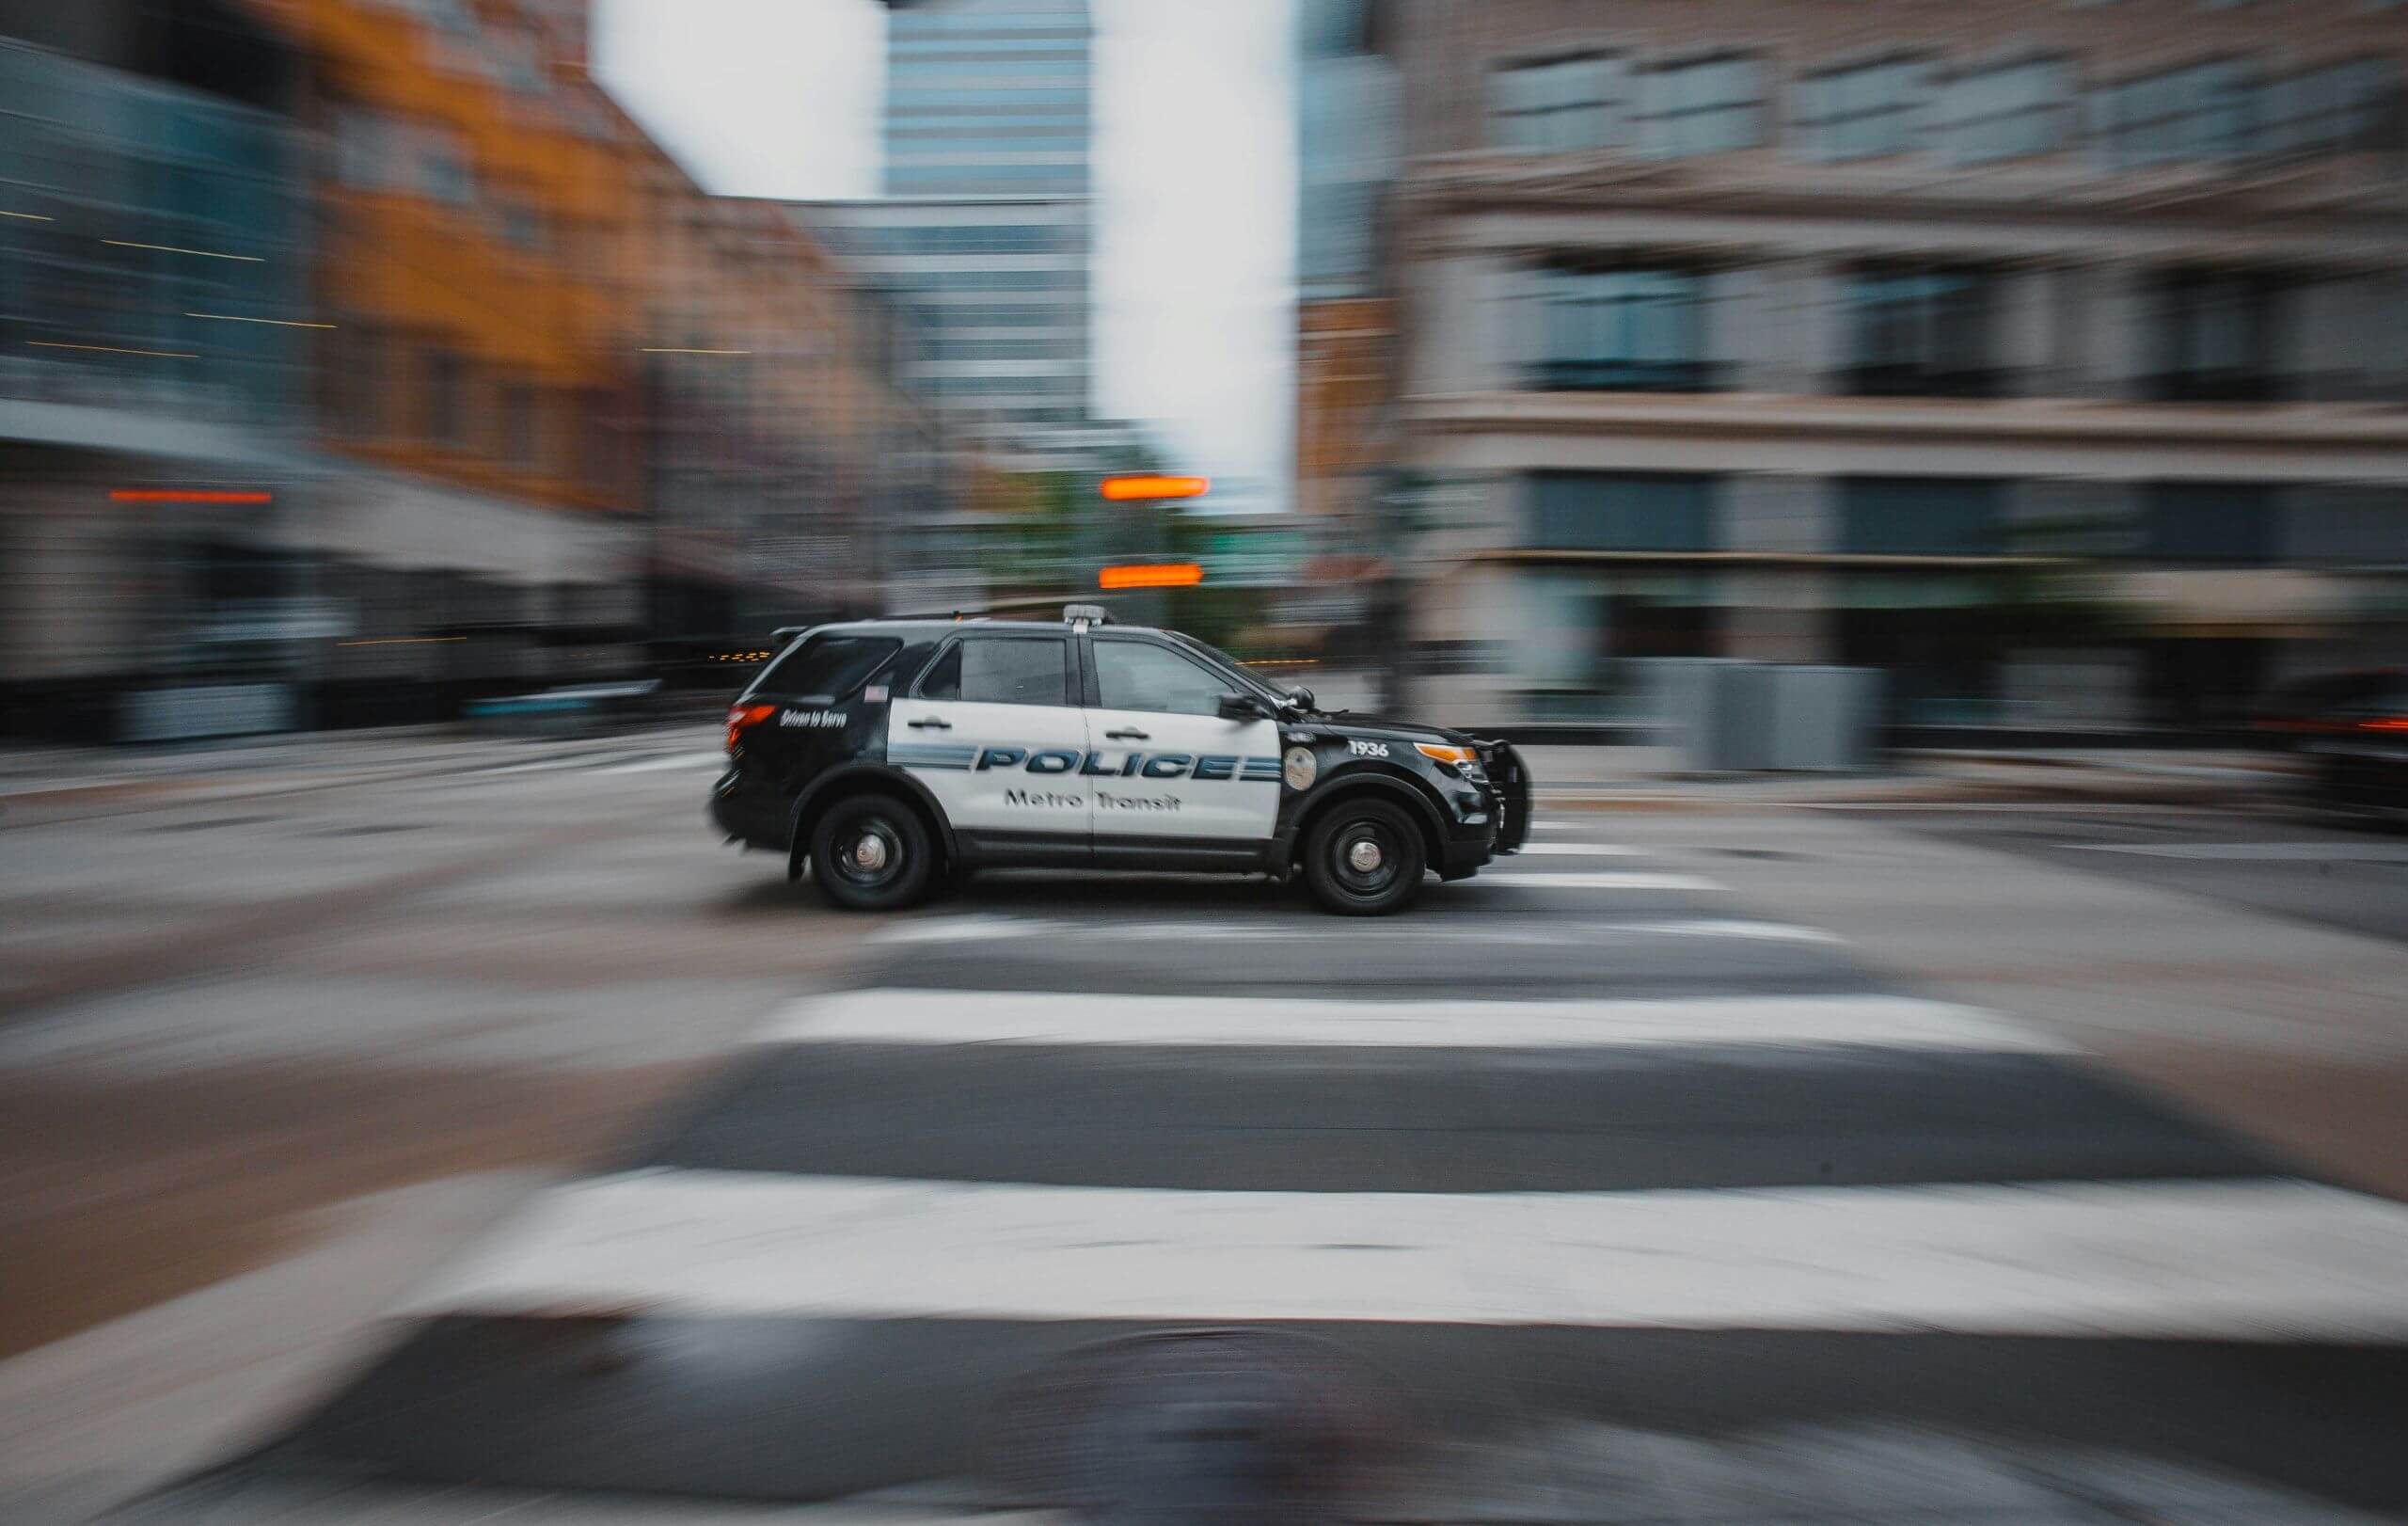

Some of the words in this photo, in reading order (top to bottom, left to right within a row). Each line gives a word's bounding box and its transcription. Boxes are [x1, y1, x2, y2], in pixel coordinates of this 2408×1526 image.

[780, 708, 810, 728] Driven
[810, 709, 821, 727] to
[820, 708, 848, 728] Serve
[1348, 739, 1389, 757] 1936
[974, 747, 1239, 781] POLICE
[1006, 788, 1084, 808] Metro
[1095, 789, 1182, 812] Transit
